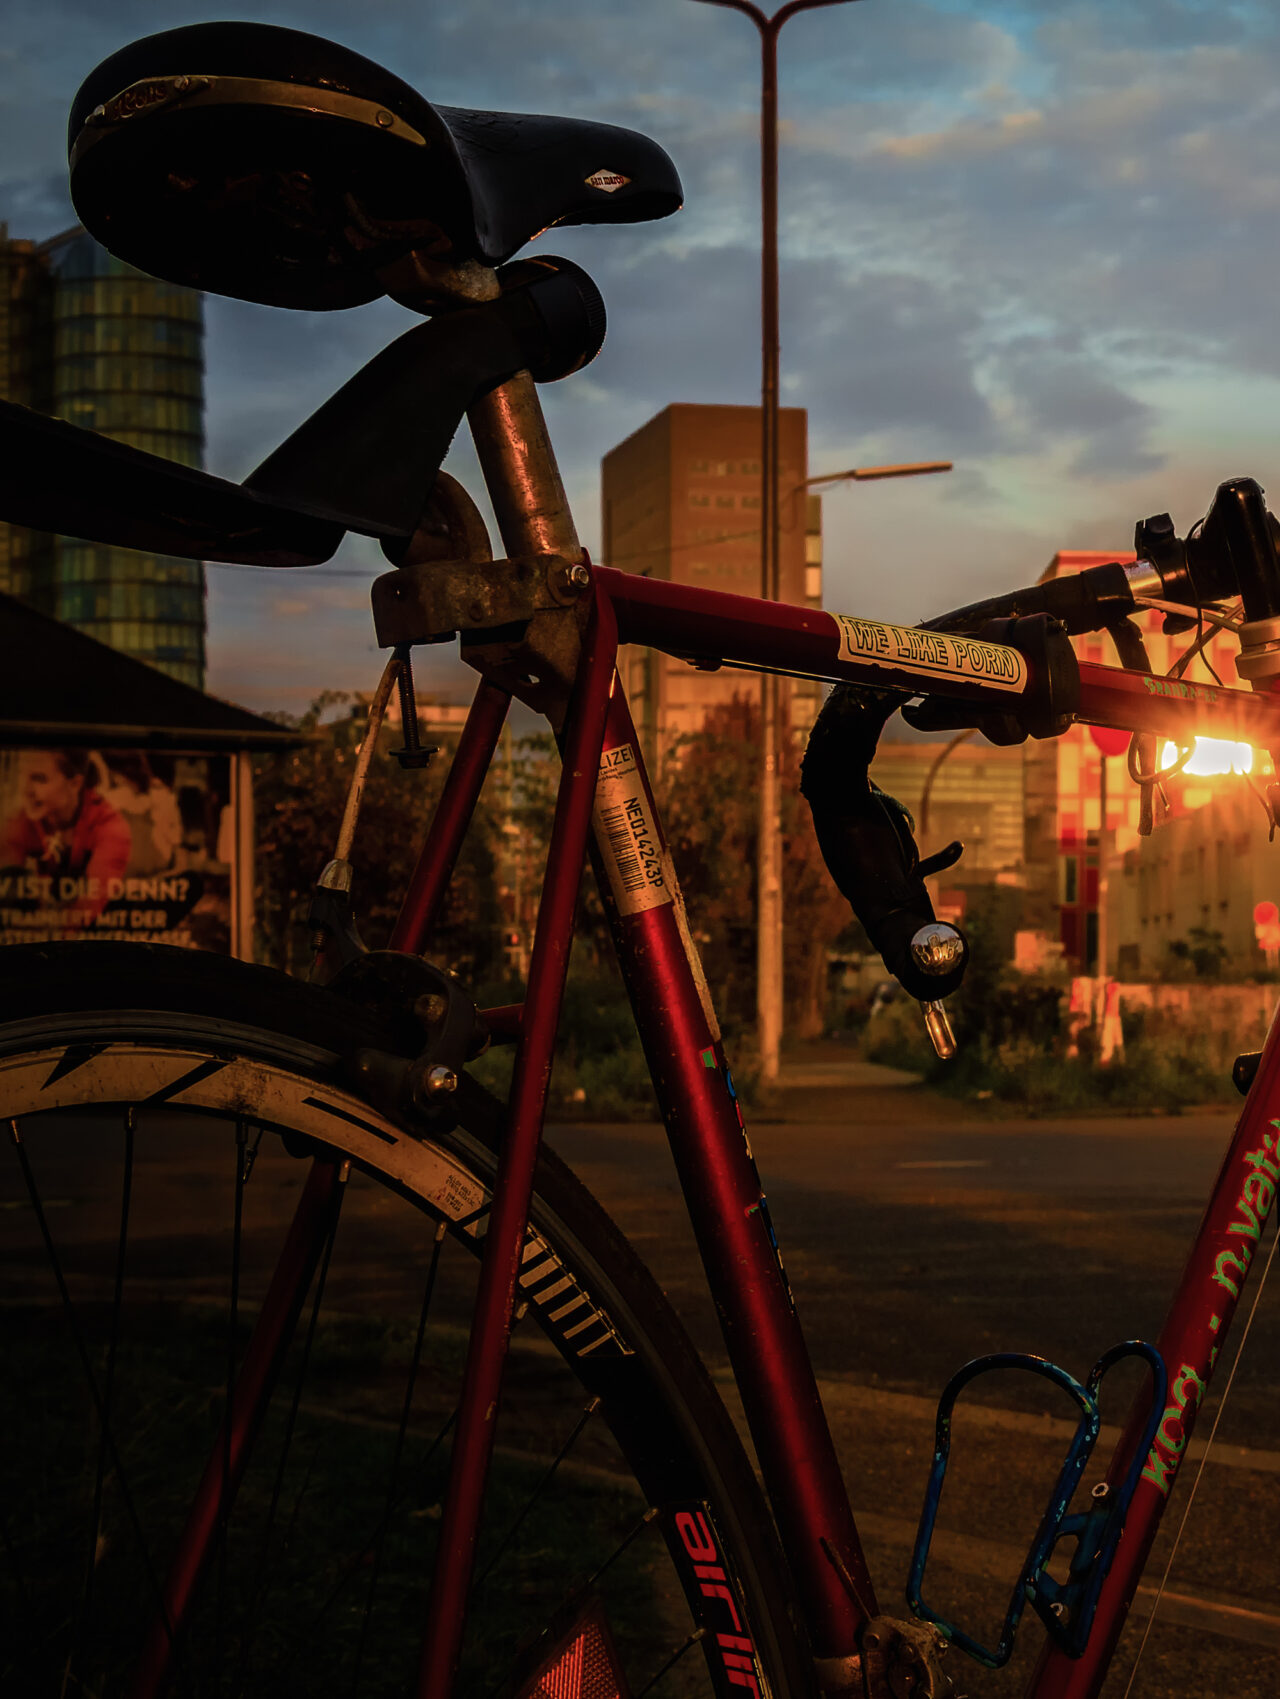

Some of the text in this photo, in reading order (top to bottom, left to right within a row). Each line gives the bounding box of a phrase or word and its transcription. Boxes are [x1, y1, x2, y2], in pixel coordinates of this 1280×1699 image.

[850, 620, 1014, 678] WE LIKE PORN
[17, 877, 53, 900] IST
[60, 877, 101, 901] DIE
[107, 878, 190, 902] DENN?
[96, 909, 127, 928] MIT
[130, 909, 168, 929] DER
